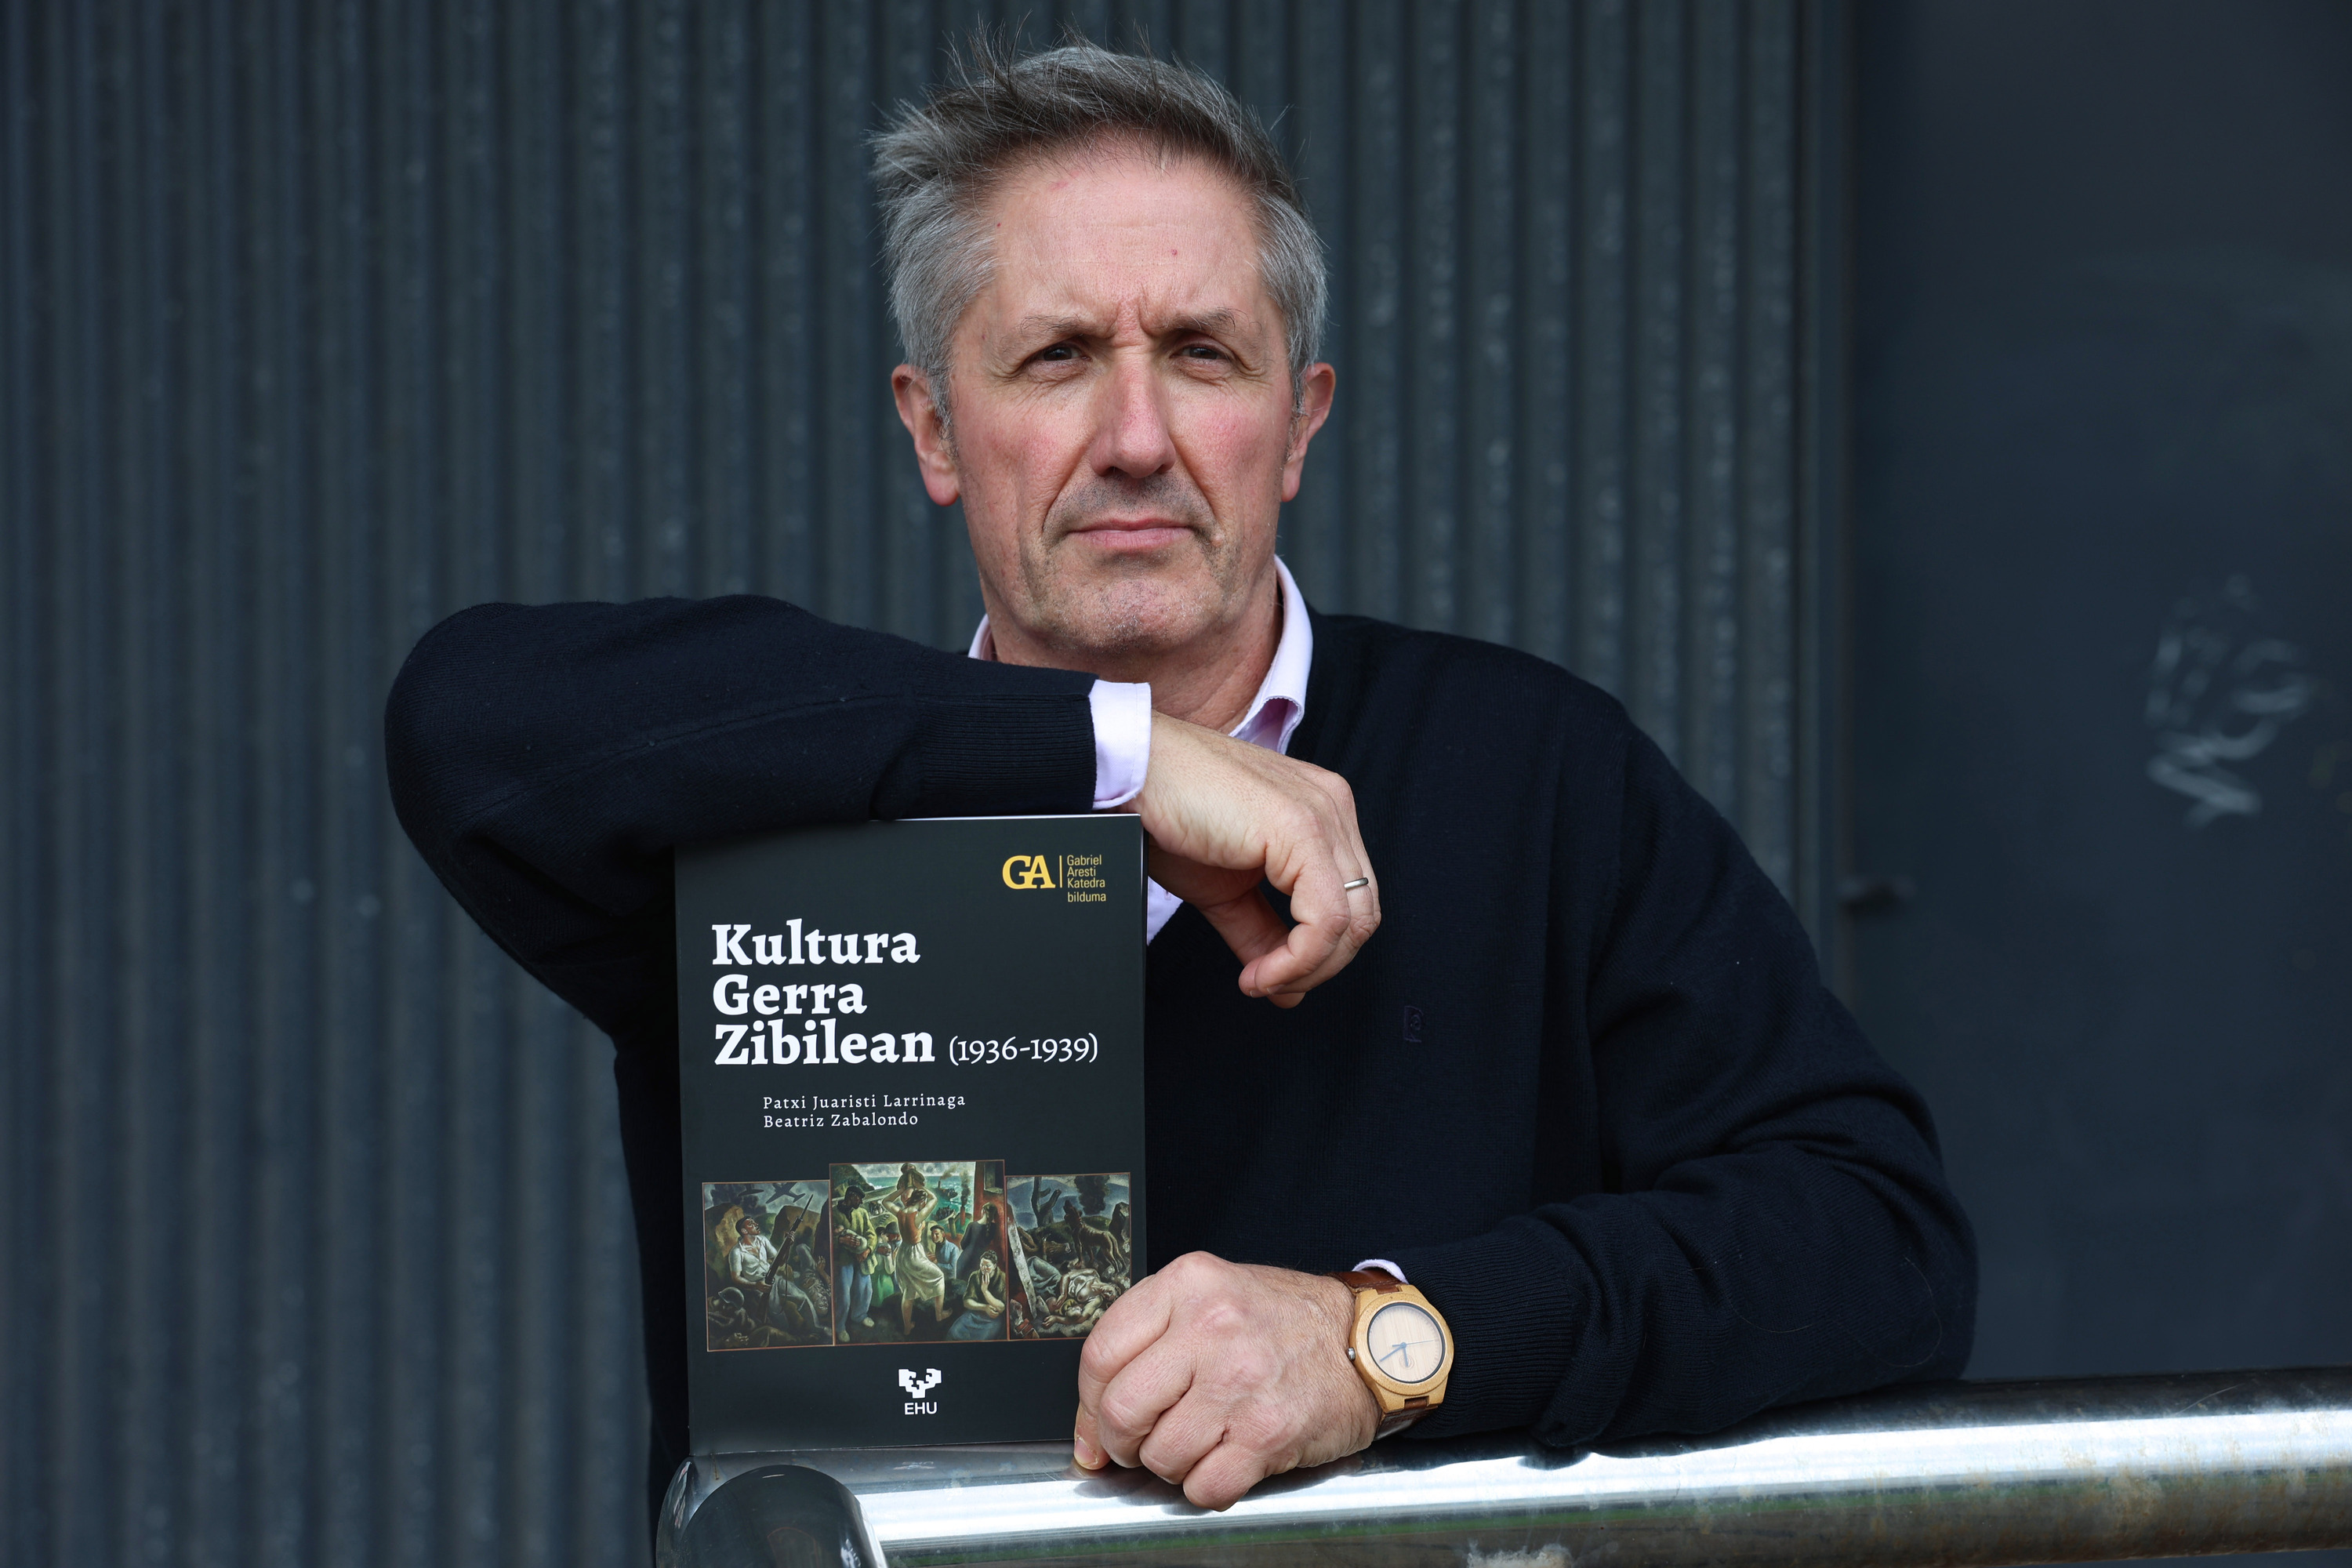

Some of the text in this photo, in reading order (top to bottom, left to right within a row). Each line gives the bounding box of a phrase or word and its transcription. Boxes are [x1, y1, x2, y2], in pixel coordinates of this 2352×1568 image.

[1066, 854, 1102, 866] Gabriel
[1002, 855, 1056, 890] GA
[1066, 866, 1097, 877] Aresti
[1067, 877, 1105, 888] Katedra
[1067, 891, 1106, 902] bilduma
[711, 918, 921, 966] Kultura
[713, 974, 868, 1016] Gerra
[714, 1018, 1098, 1066] Zibilean (1936-1939)
[763, 1093, 966, 1110] Patxi Juaristi Larrinaga
[764, 1111, 918, 1128] Beatriz Zabalondo
[904, 1401, 938, 1415] EHU
